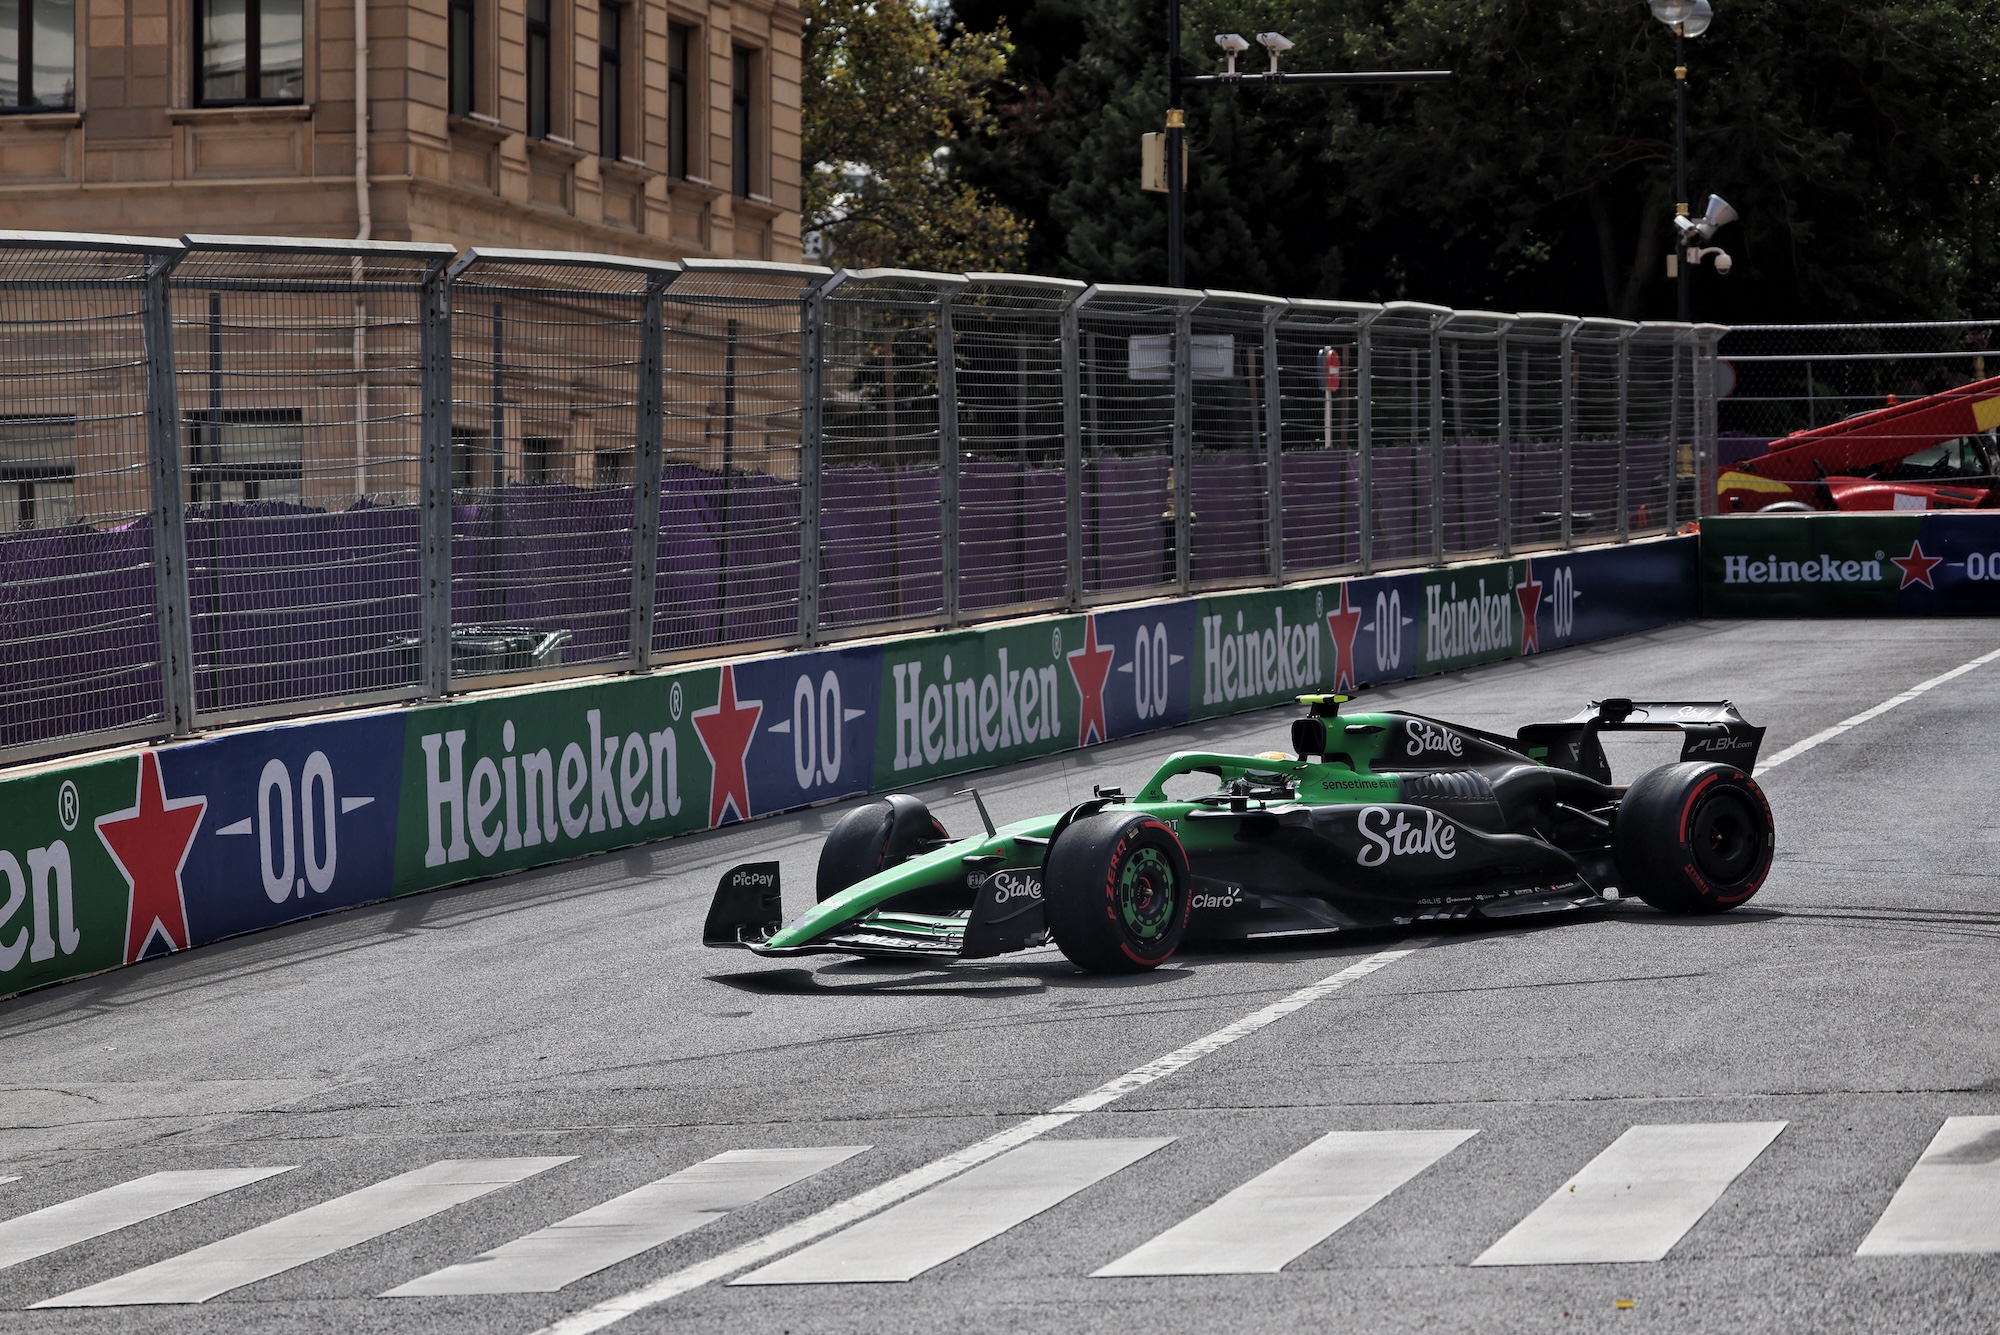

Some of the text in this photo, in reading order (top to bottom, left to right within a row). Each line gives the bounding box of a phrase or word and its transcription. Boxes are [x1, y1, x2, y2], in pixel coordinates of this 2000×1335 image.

[1724, 554, 1883, 584] Heineken
[1425, 566, 1574, 662] Heineken 0.0
[1202, 588, 1400, 706] Heineken 0.0
[893, 621, 1168, 772] Heineken 0.0
[1405, 719, 1463, 758] Stake
[1705, 736, 1753, 752] LBX.com
[420, 669, 842, 868] Heineken 0.0
[1322, 779, 1378, 790] sensetime
[256, 750, 337, 904] 0.0
[1356, 806, 1457, 867] Stake
[732, 871, 774, 887] PicPay
[994, 873, 1042, 904] Stake
[1105, 838, 1127, 920] P ZERO
[1191, 893, 1234, 909] Claro
